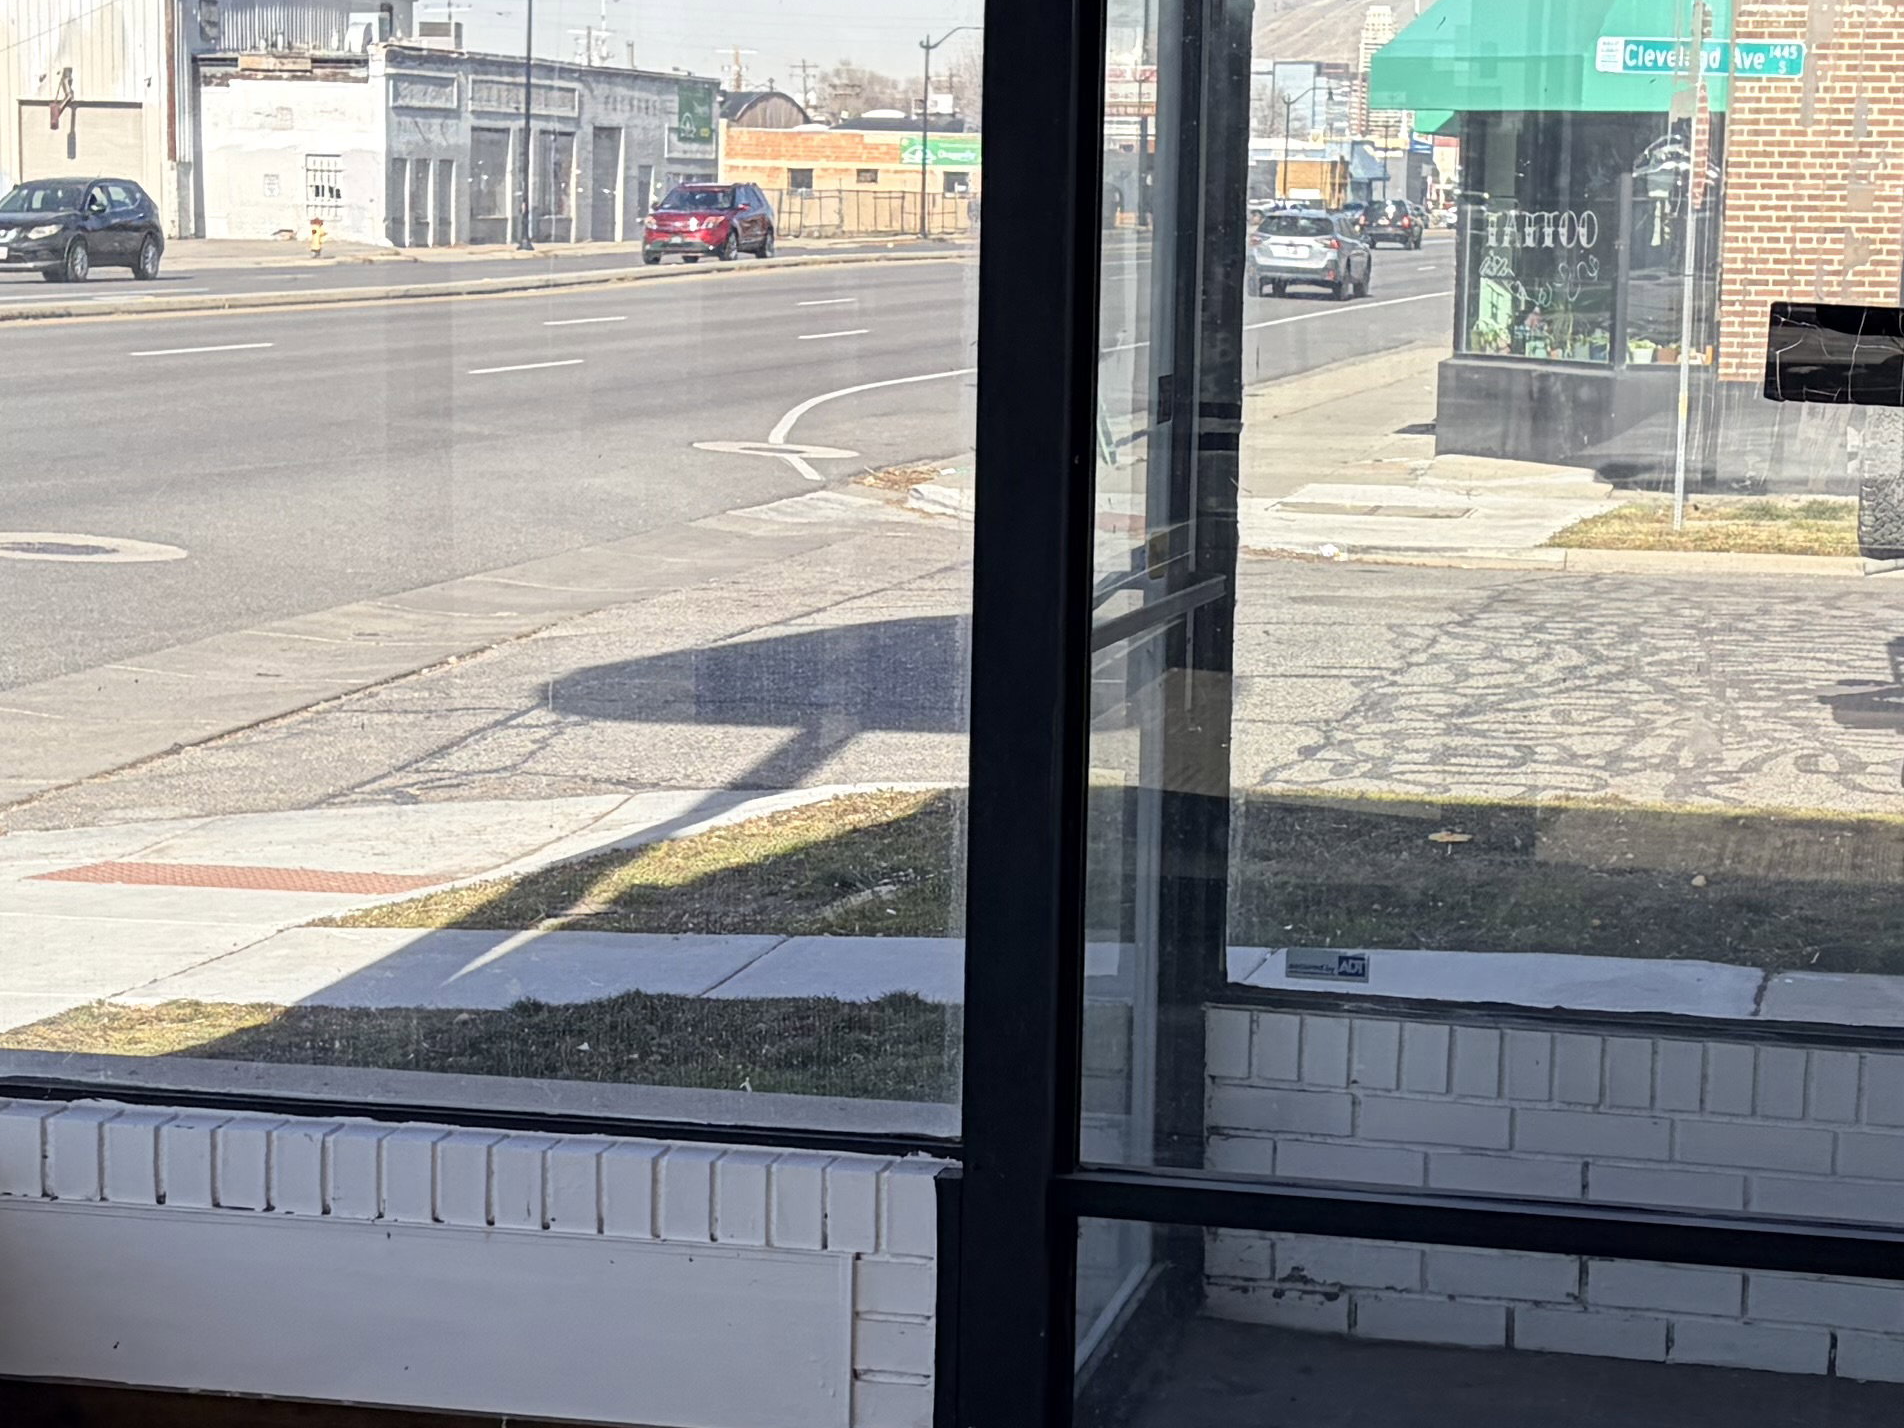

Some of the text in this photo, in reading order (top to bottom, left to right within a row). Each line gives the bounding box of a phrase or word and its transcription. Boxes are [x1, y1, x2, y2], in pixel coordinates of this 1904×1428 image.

[1734, 46, 1766, 70] Ave
[1768, 45, 1798, 60] 1445
[1483, 209, 1599, 248] TATTOO
